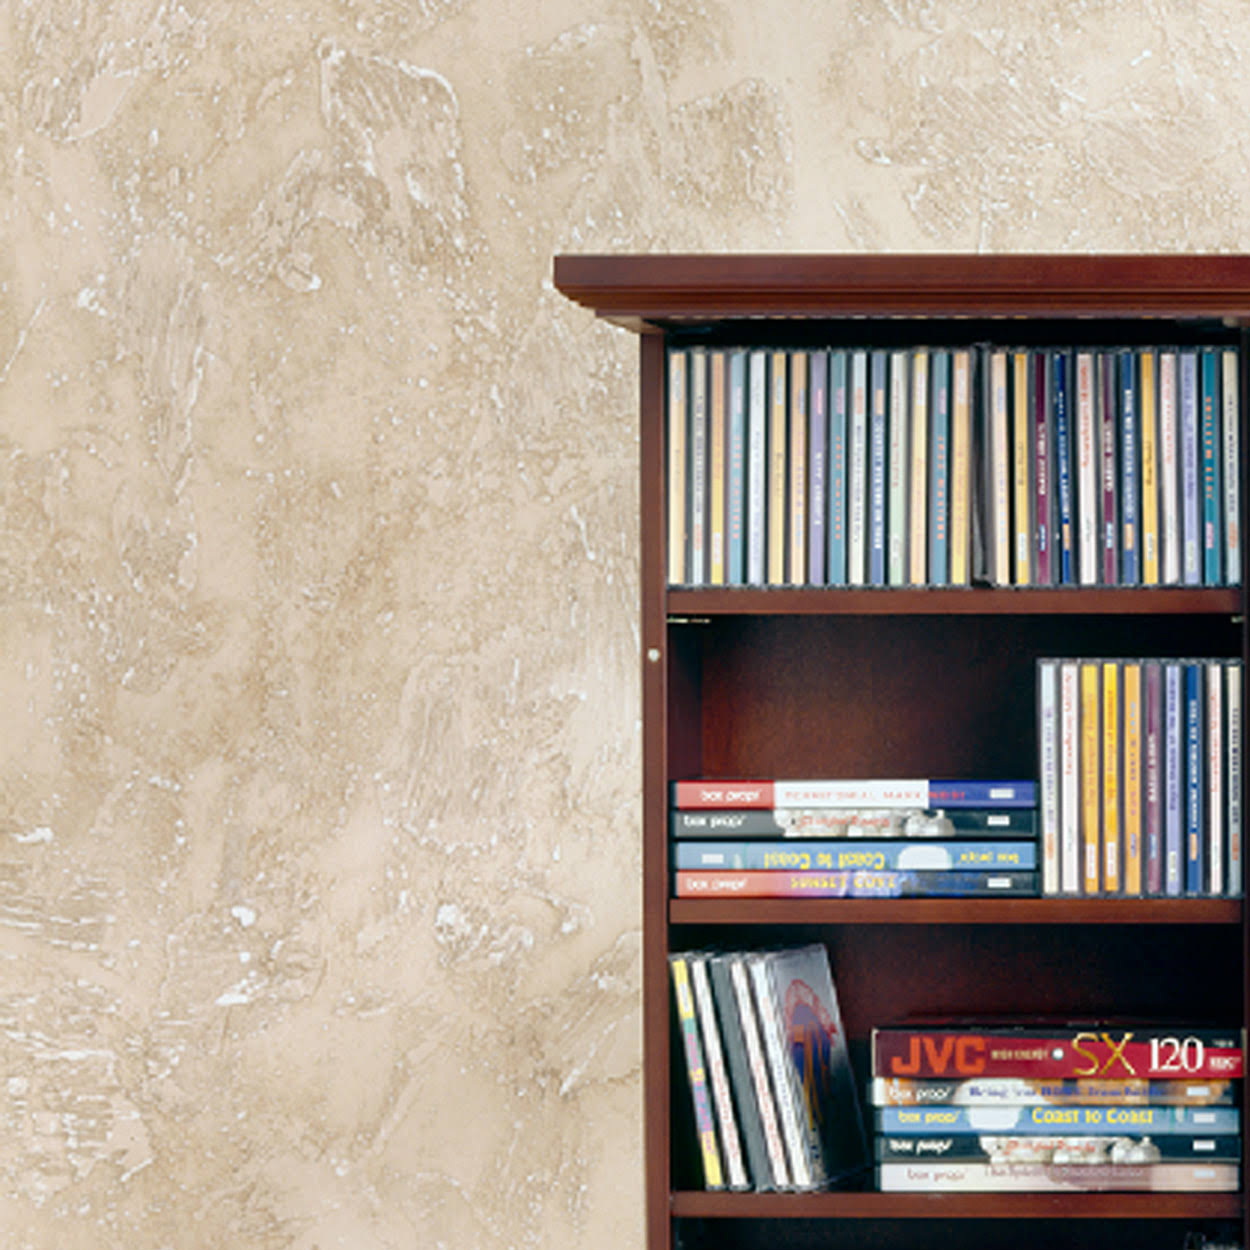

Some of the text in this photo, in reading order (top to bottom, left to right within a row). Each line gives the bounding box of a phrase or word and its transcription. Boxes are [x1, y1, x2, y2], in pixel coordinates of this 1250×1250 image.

[891, 1036, 986, 1075] JVC
[1072, 1032, 1136, 1075] SX
[1149, 1036, 1204, 1073] 120
[898, 1110, 922, 1123] box
[1032, 1107, 1154, 1124] Coast to Coast
